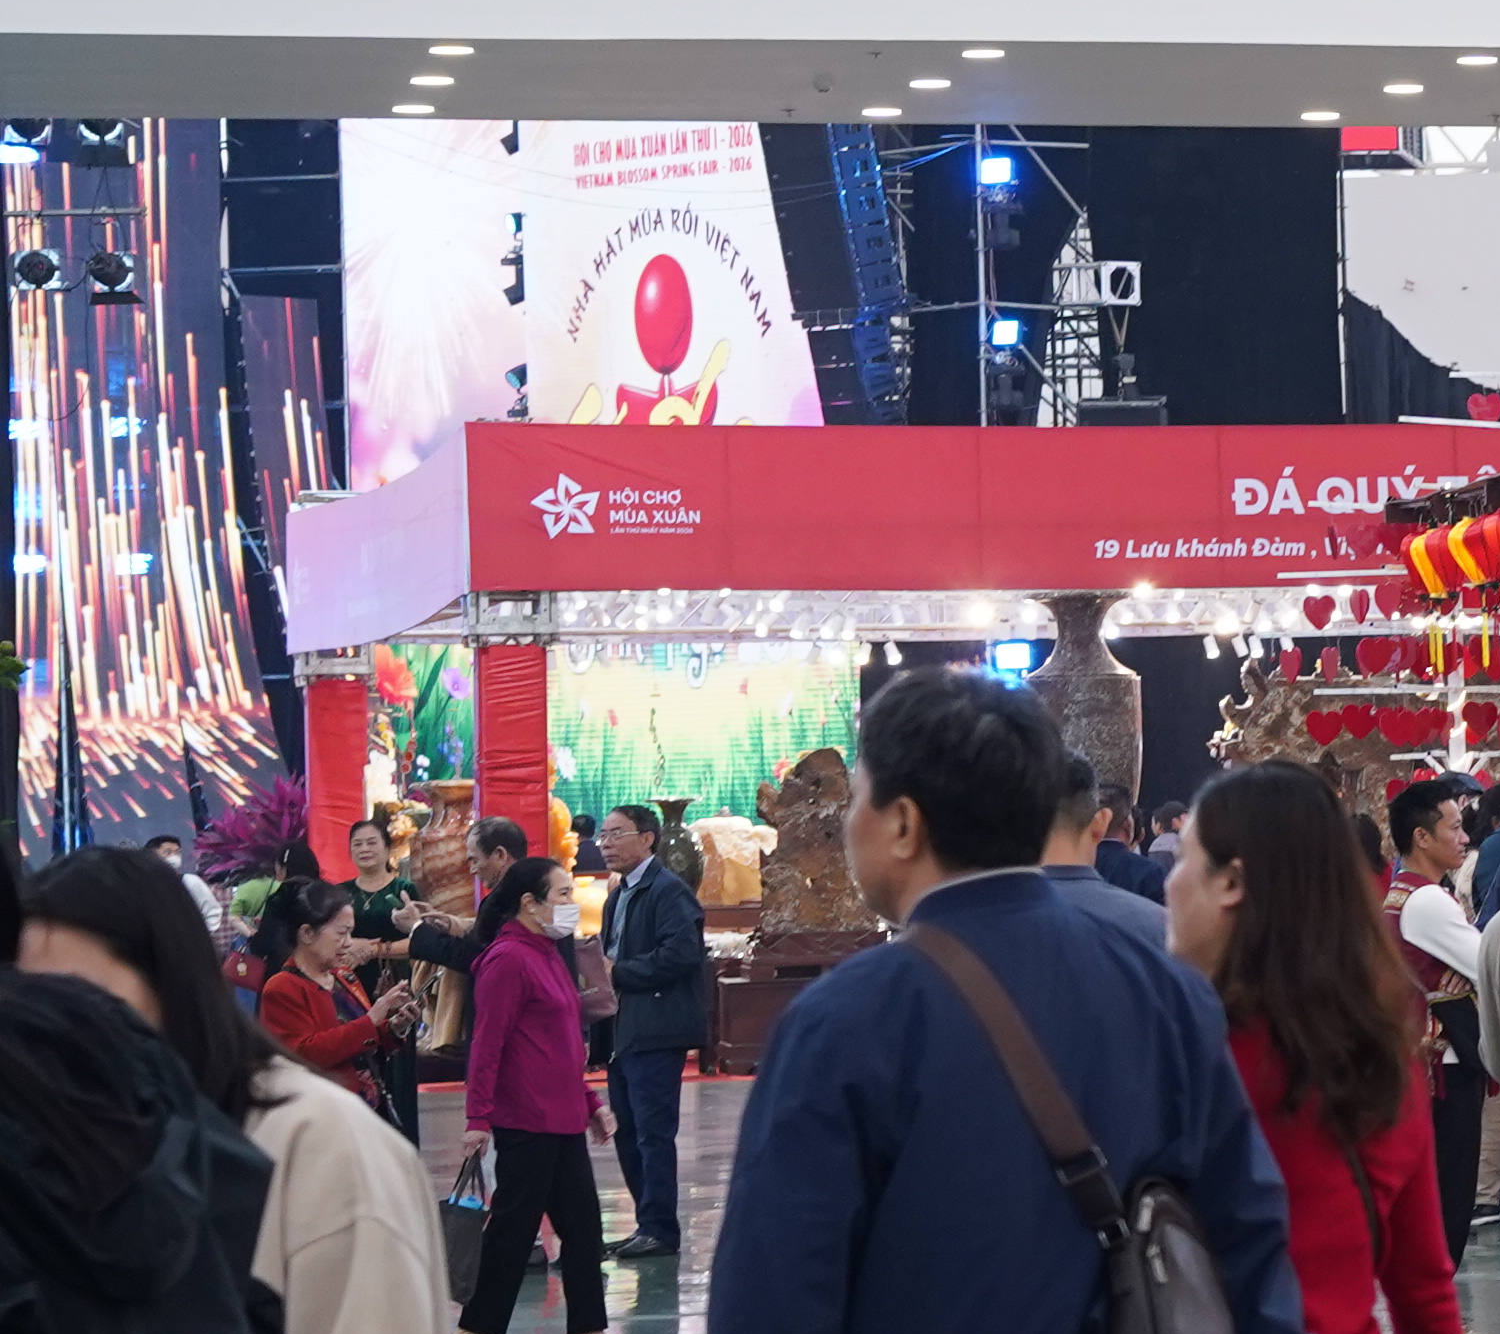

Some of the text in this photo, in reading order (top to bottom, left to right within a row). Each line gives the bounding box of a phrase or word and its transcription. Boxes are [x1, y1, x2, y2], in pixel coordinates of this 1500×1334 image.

[728, 123, 753, 149] 2026
[576, 171, 614, 189] VIETNAM
[617, 168, 658, 186] BLOSSOM
[662, 162, 695, 180] SPRING
[698, 159, 719, 176] FAIR
[729, 156, 752, 173] 2026
[740, 266, 772, 338] NAM
[608, 486, 682, 507] HỘI CHỢ
[1231, 465, 1305, 516] ĐÁ
[1316, 464, 1425, 515] QUÝ
[652, 507, 701, 525] XUÂN
[1093, 539, 1119, 559] 19
[1125, 538, 1170, 559] Lưu
[1175, 536, 1243, 558] khánh
[1251, 537, 1306, 558] Đàm
